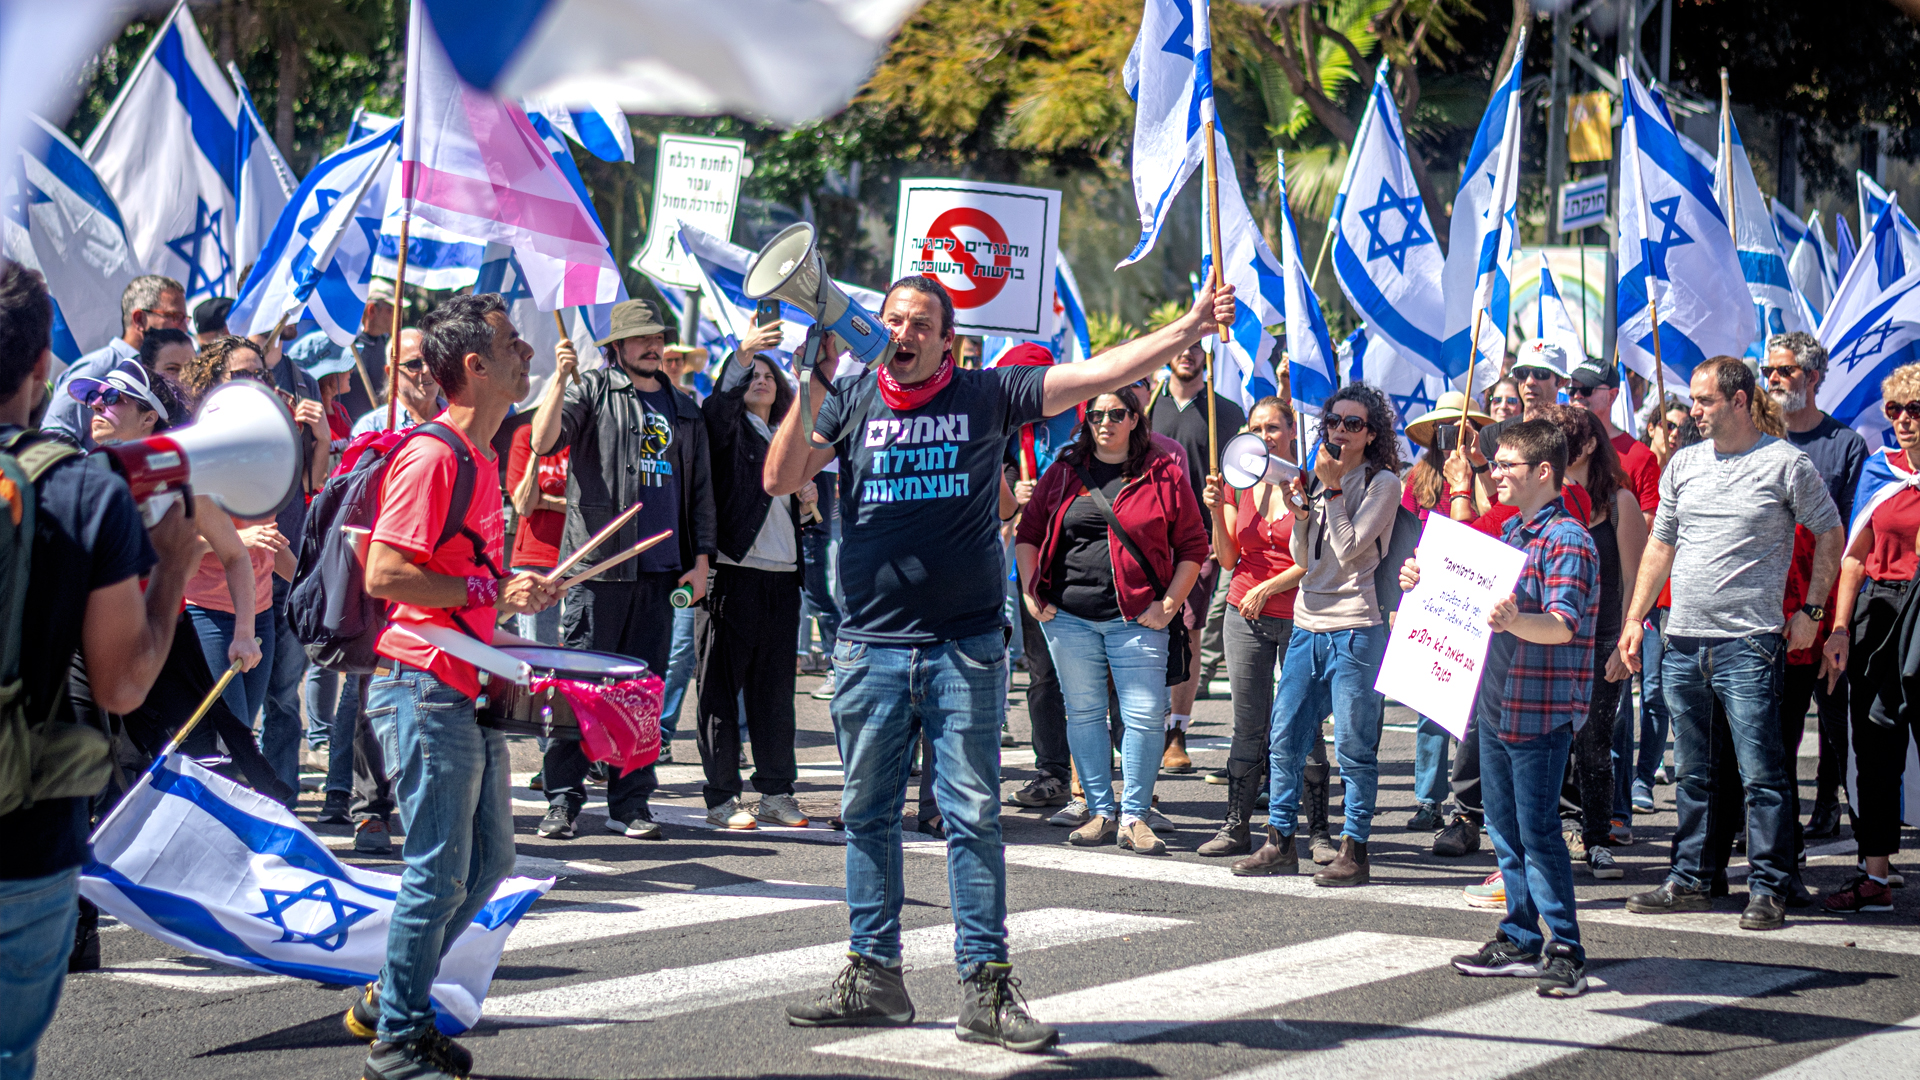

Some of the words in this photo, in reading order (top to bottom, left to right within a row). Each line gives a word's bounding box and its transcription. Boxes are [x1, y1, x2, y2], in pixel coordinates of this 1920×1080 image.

[687, 176, 711, 192] עבור
[663, 192, 687, 210] ממול
[688, 199, 729, 215] למדרכה
[1564, 193, 1605, 217] חוקה!
[911, 237, 956, 251] לפגיעה
[964, 240, 1029, 258] מתנגדים
[910, 260, 964, 275] השופטת
[973, 264, 1025, 280] ברשות
[865, 413, 969, 448] נאמנים
[872, 442, 959, 474] למגילת
[862, 473, 970, 503] העצמאות
[1407, 628, 1432, 647] רוצים
[1433, 635, 1448, 653] לא
[1444, 645, 1465, 663] באמת
